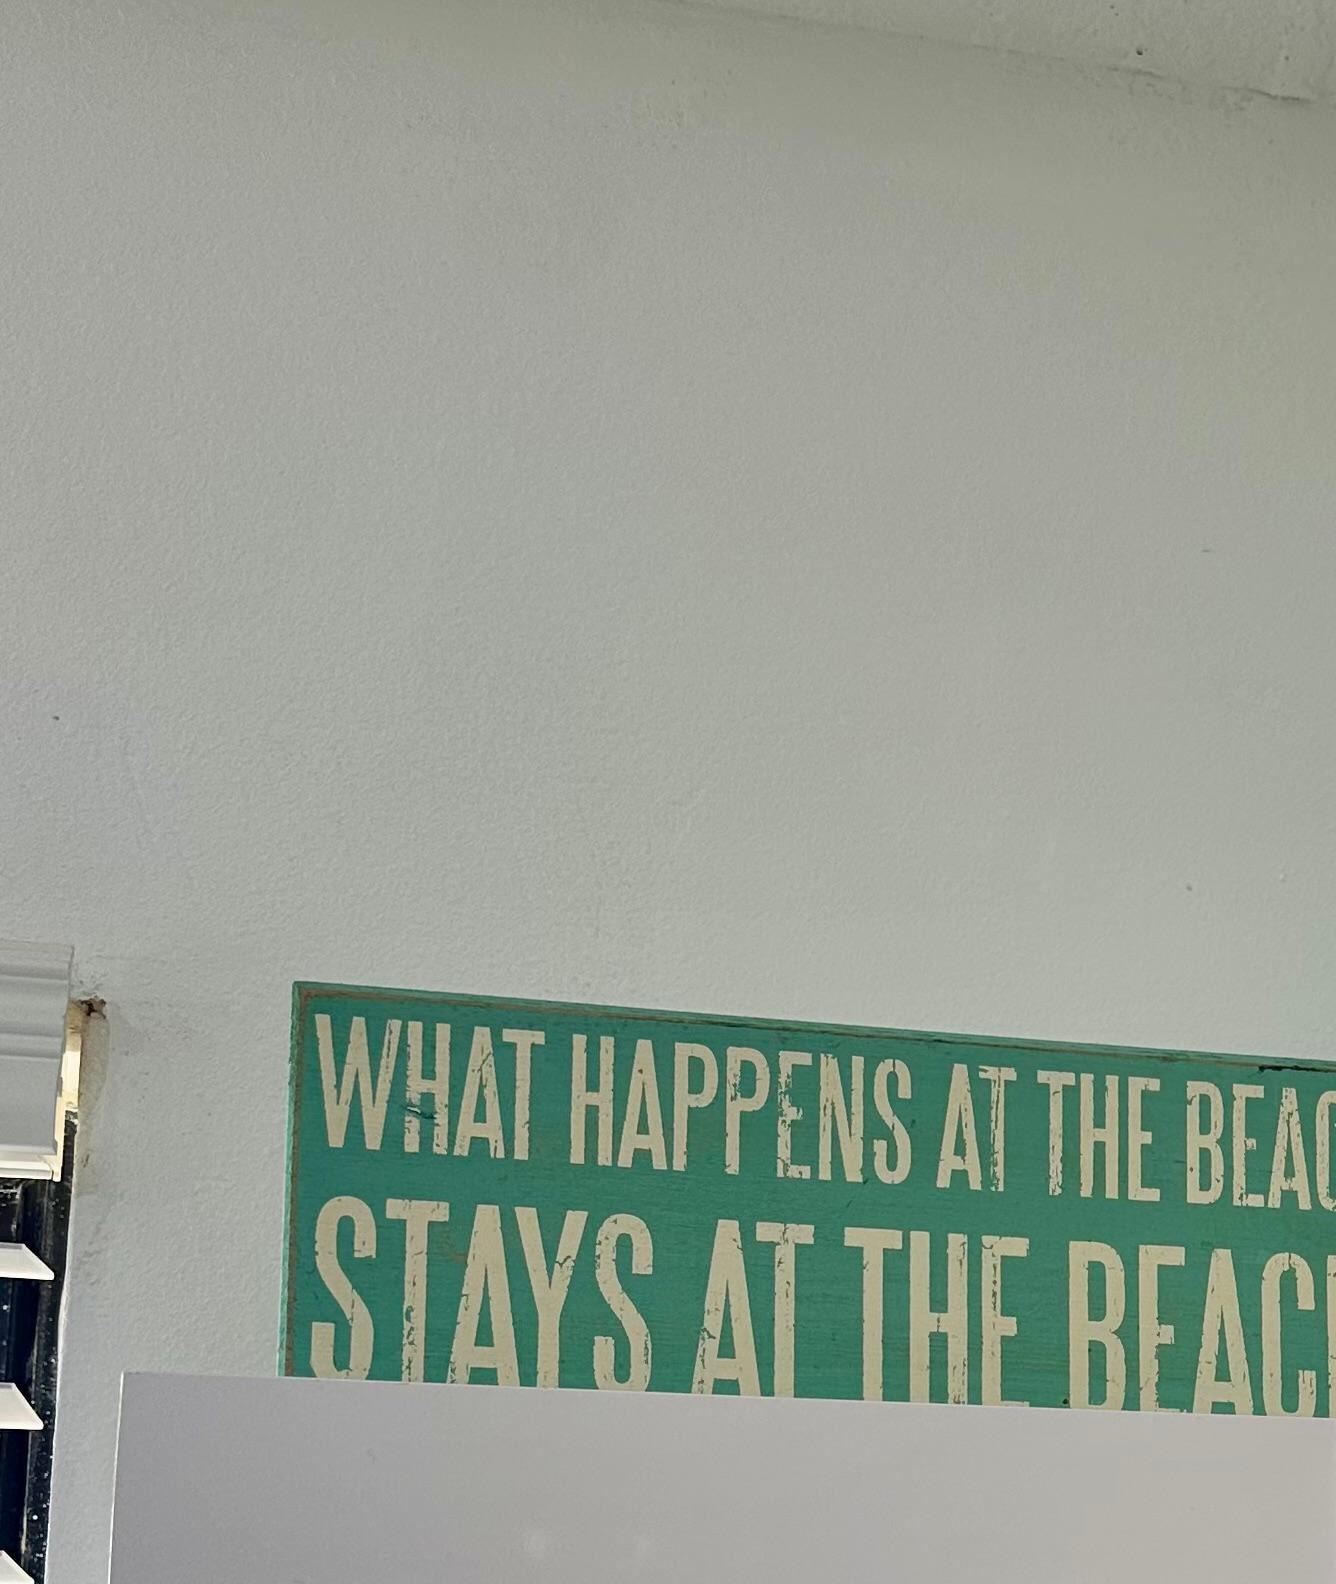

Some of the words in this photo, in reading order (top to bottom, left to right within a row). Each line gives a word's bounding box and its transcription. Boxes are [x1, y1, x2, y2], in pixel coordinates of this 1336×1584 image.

[315, 1013, 545, 1160] WHAT
[570, 1033, 912, 1185] HAPPENS
[936, 1063, 1017, 1192] AT
[1037, 1070, 1160, 1202] THE
[310, 1196, 653, 1391] STAYS
[692, 1219, 814, 1398] AT
[844, 1227, 1029, 1407] THE
